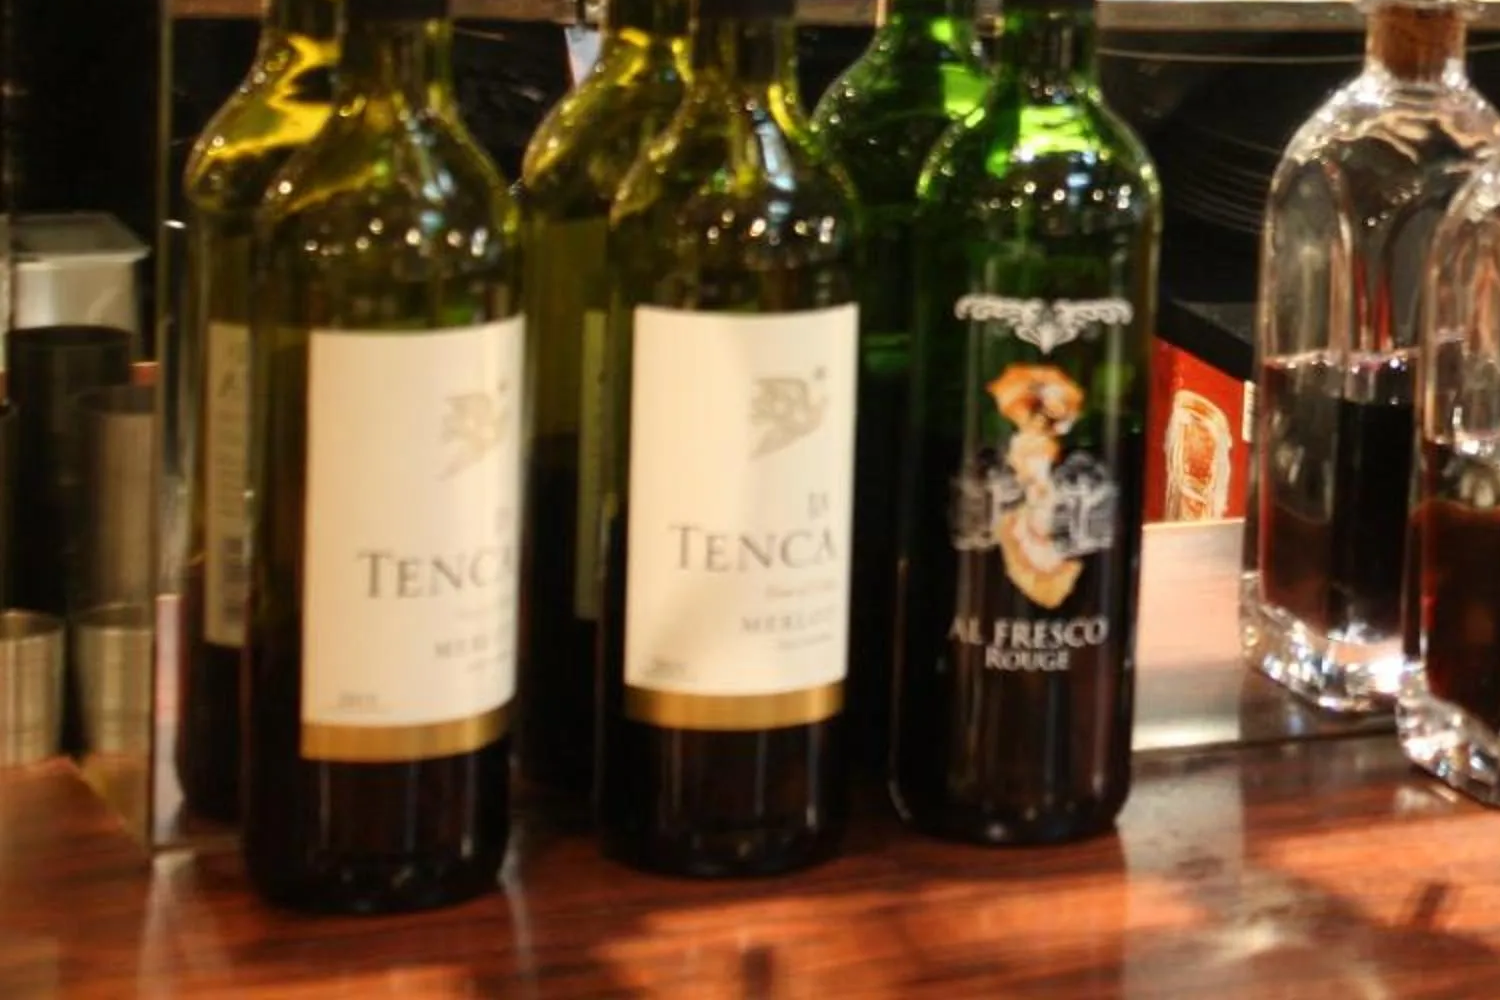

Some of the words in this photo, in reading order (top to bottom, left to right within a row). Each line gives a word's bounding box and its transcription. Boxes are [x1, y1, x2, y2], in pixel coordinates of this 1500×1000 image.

[666, 522, 838, 574] TENCA
[947, 615, 984, 648] AL
[994, 614, 1109, 650] FRESCO
[985, 646, 1071, 672] ROUGE
